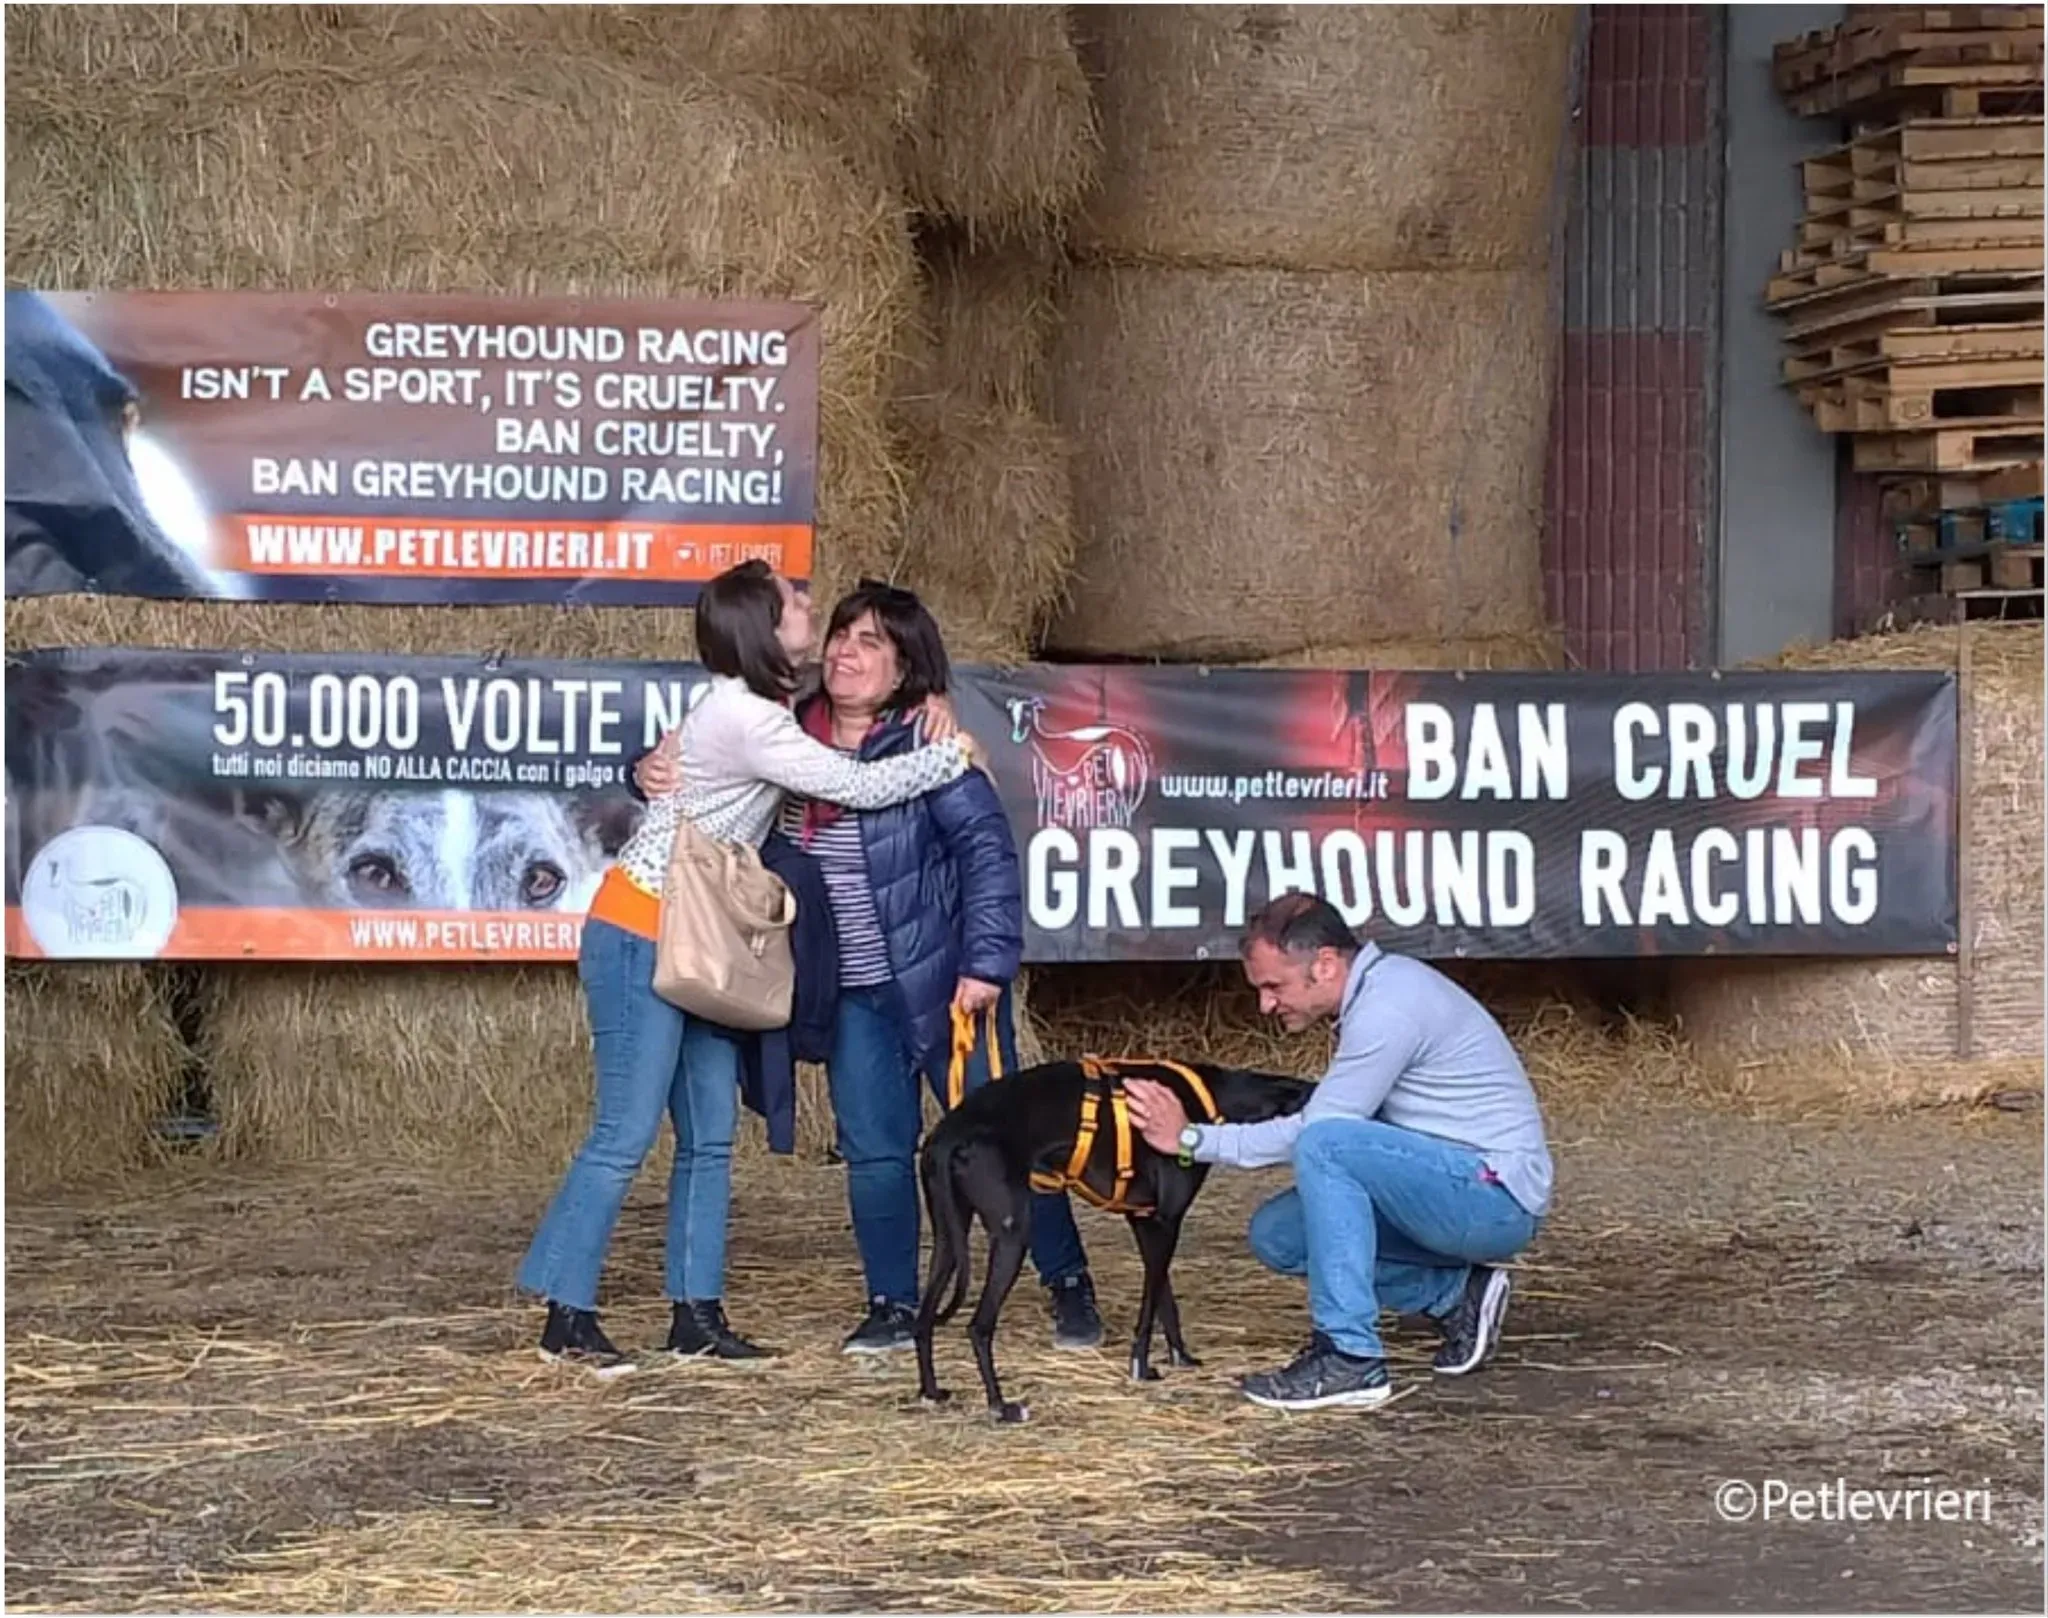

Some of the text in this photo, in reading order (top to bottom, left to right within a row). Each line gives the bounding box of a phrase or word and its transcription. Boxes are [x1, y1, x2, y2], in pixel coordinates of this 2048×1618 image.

[365, 323, 787, 366] GREYHOUND RACING
[181, 369, 787, 414] ISN'T A SPORT, IT'S CRUELTY.
[496, 419, 785, 466] BAN CRUELTY,
[251, 458, 783, 505] BAN GREYHOUND RACING!
[247, 524, 653, 570] WWW.PETLEVRIERI.IT
[213, 671, 710, 754] 50.000 VOLTE N
[212, 753, 248, 777] tutti
[254, 754, 282, 777] noi
[287, 754, 360, 778] diciamo
[364, 756, 391, 779] NO
[395, 756, 442, 779] ALLA
[446, 757, 512, 780] CACCIA
[516, 763, 549, 782] con
[554, 760, 560, 781] i
[1406, 701, 1878, 801] BAN CRUEL
[1160, 771, 1389, 804] www.petlevrieri.it
[1028, 828, 1878, 928] GREYHOUND RACING
